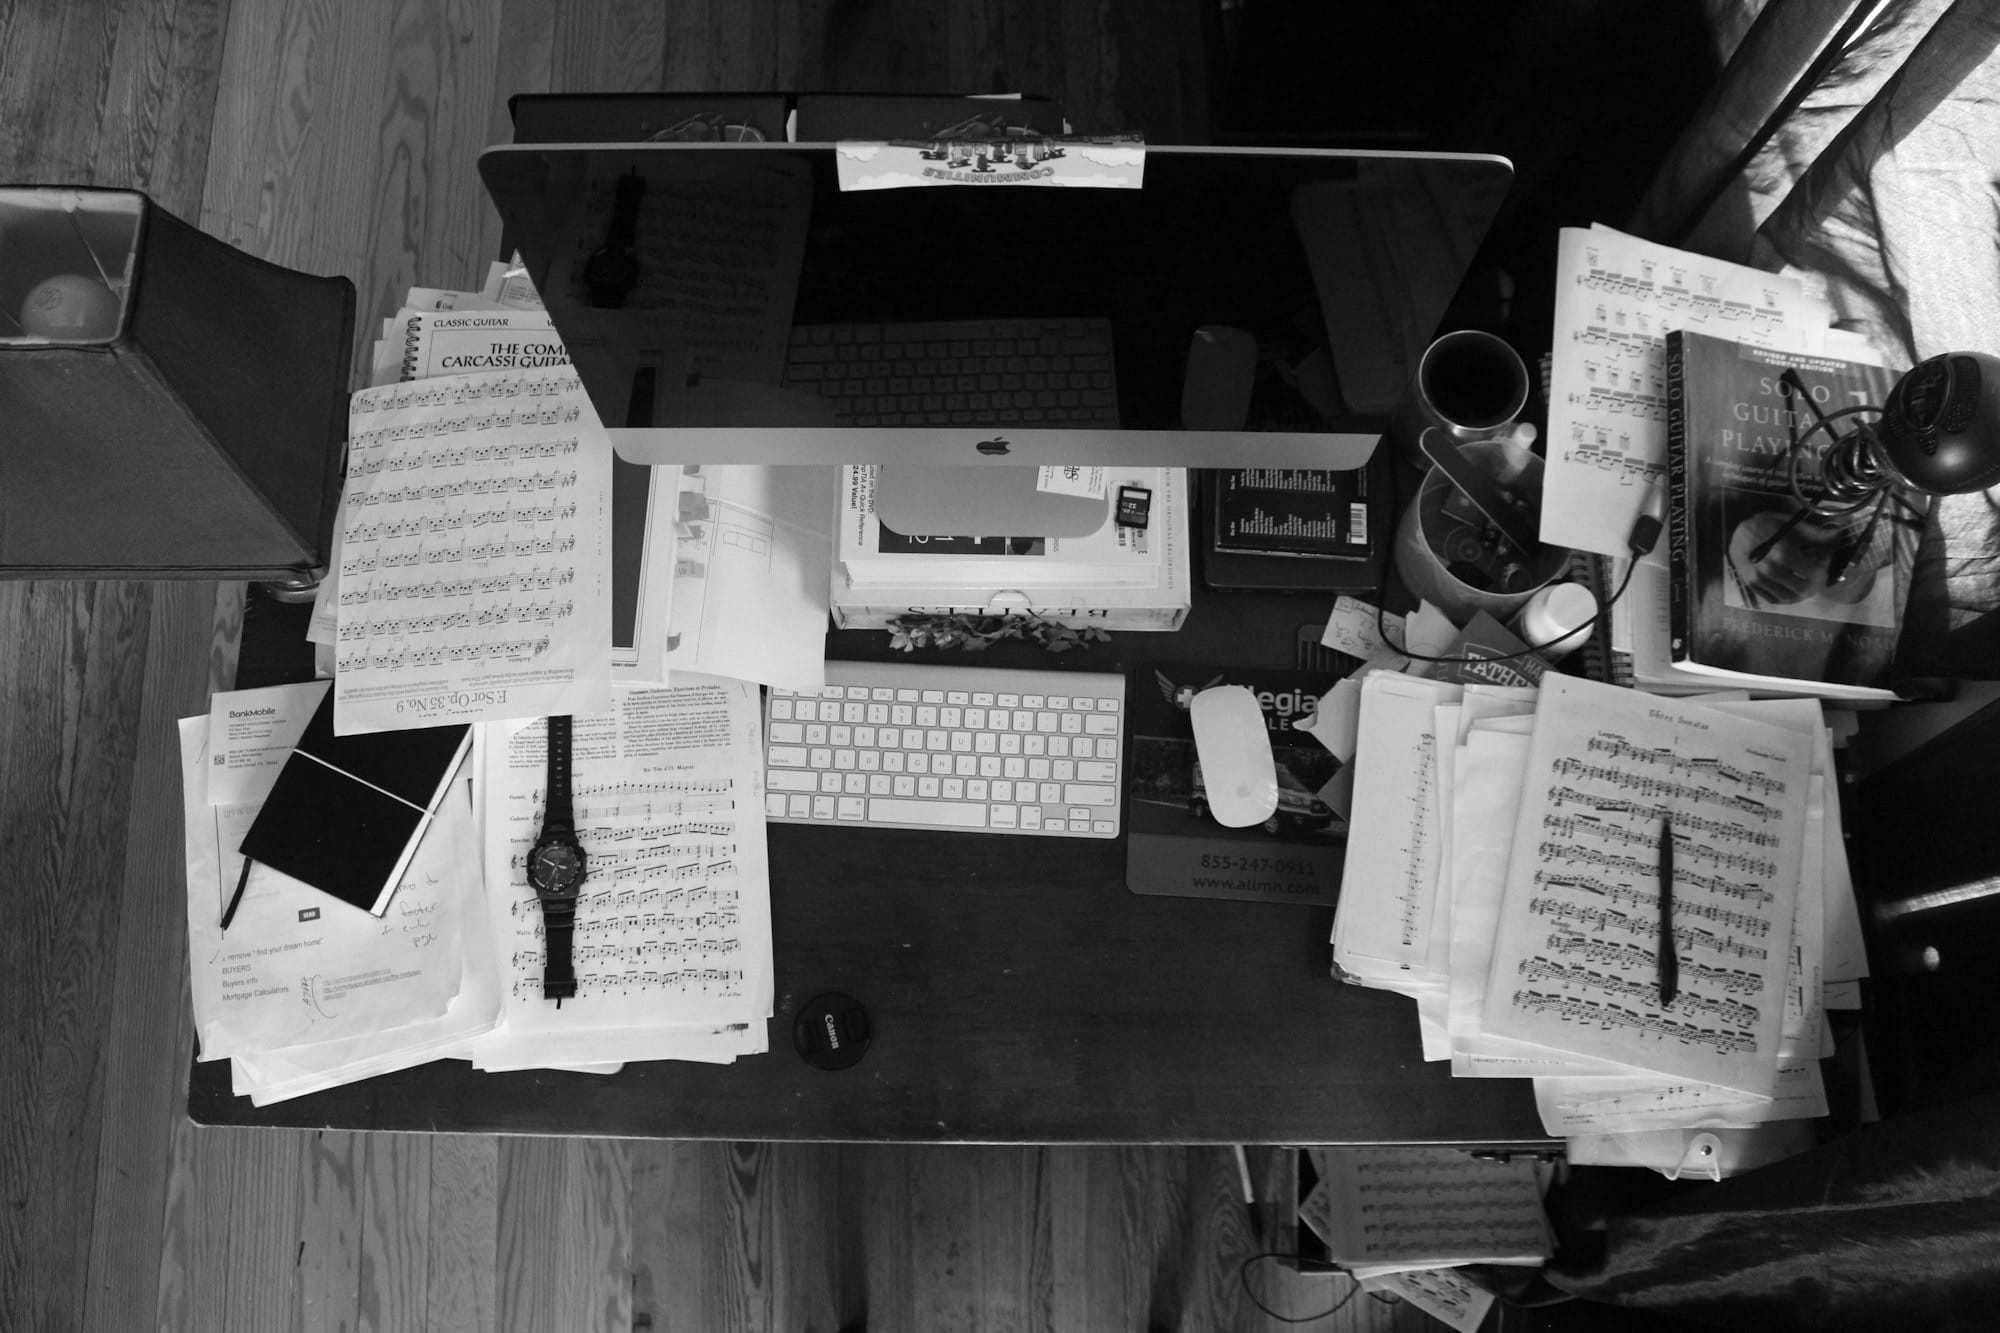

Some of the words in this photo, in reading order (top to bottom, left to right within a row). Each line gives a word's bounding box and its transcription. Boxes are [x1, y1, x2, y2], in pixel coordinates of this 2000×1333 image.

[922, 167, 1055, 183] COMMUNITIES
[434, 319, 472, 328] CLASSIC
[474, 318, 509, 327] GUITAR
[490, 343, 520, 355] THE
[442, 356, 516, 368] CARCASSI
[1789, 355, 1806, 363] AND
[1808, 358, 1847, 369] UPDATED
[1669, 353, 1682, 397] SOLO
[1670, 407, 1685, 482] GUITAR
[858, 513, 866, 547] Reference
[1670, 486, 1686, 562] PLAYING
[1723, 617, 1814, 641] FREDERICK
[406, 699, 427, 712] No.
[429, 696, 446, 710] 35
[447, 690, 470, 707] Op.
[472, 692, 495, 705] Sor
[229, 706, 276, 719] BankMobile
[395, 700, 405, 713] 9
[227, 952, 252, 961] remove
[269, 946, 282, 955] your
[222, 964, 252, 975] BUYERS
[222, 979, 245, 988] Buyers
[222, 991, 253, 1001] Mortgage
[824, 1013, 840, 1050] Canon
